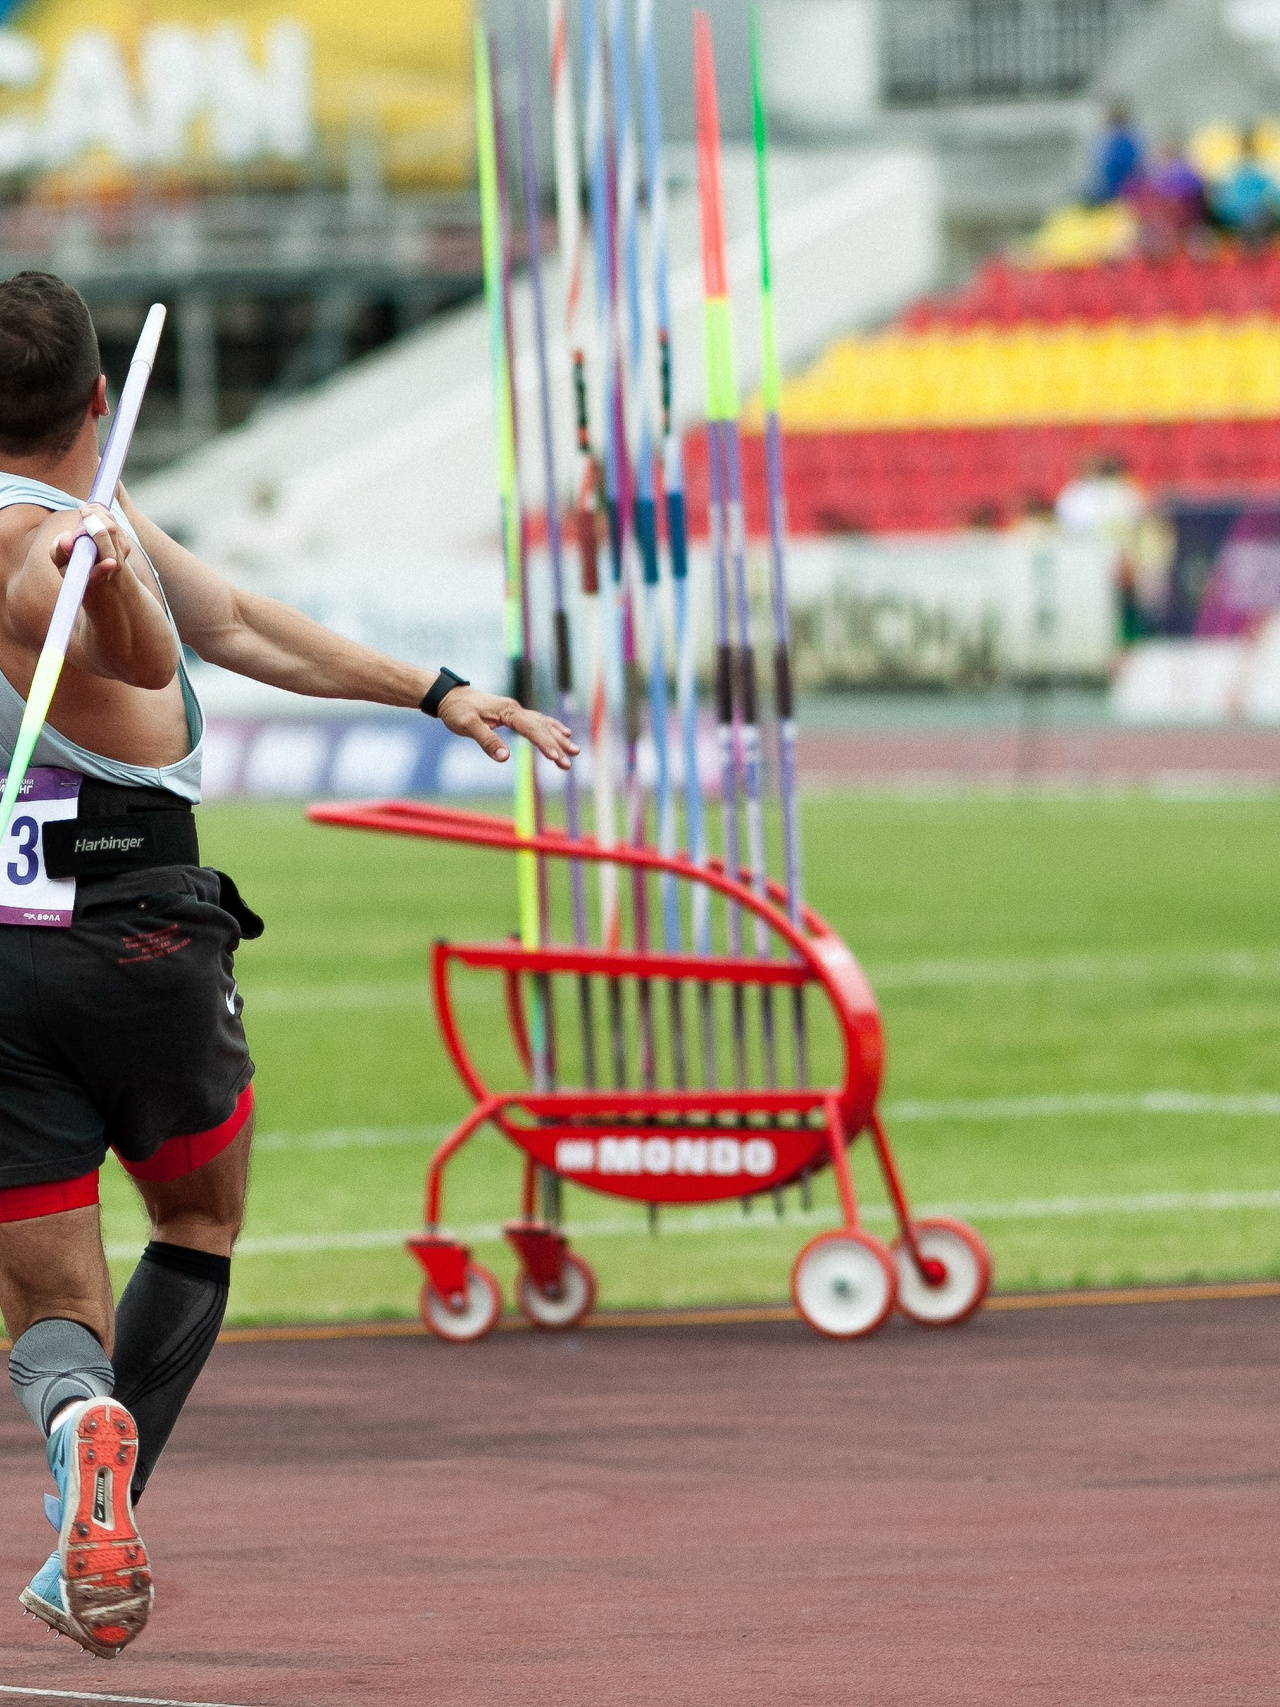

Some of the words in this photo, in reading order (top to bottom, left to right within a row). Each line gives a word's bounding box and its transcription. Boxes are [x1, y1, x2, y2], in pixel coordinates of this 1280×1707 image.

[74, 836, 144, 853] Harbinger
[37, 913, 61, 922] ВФЛА
[596, 1135, 776, 1177] MONDO
